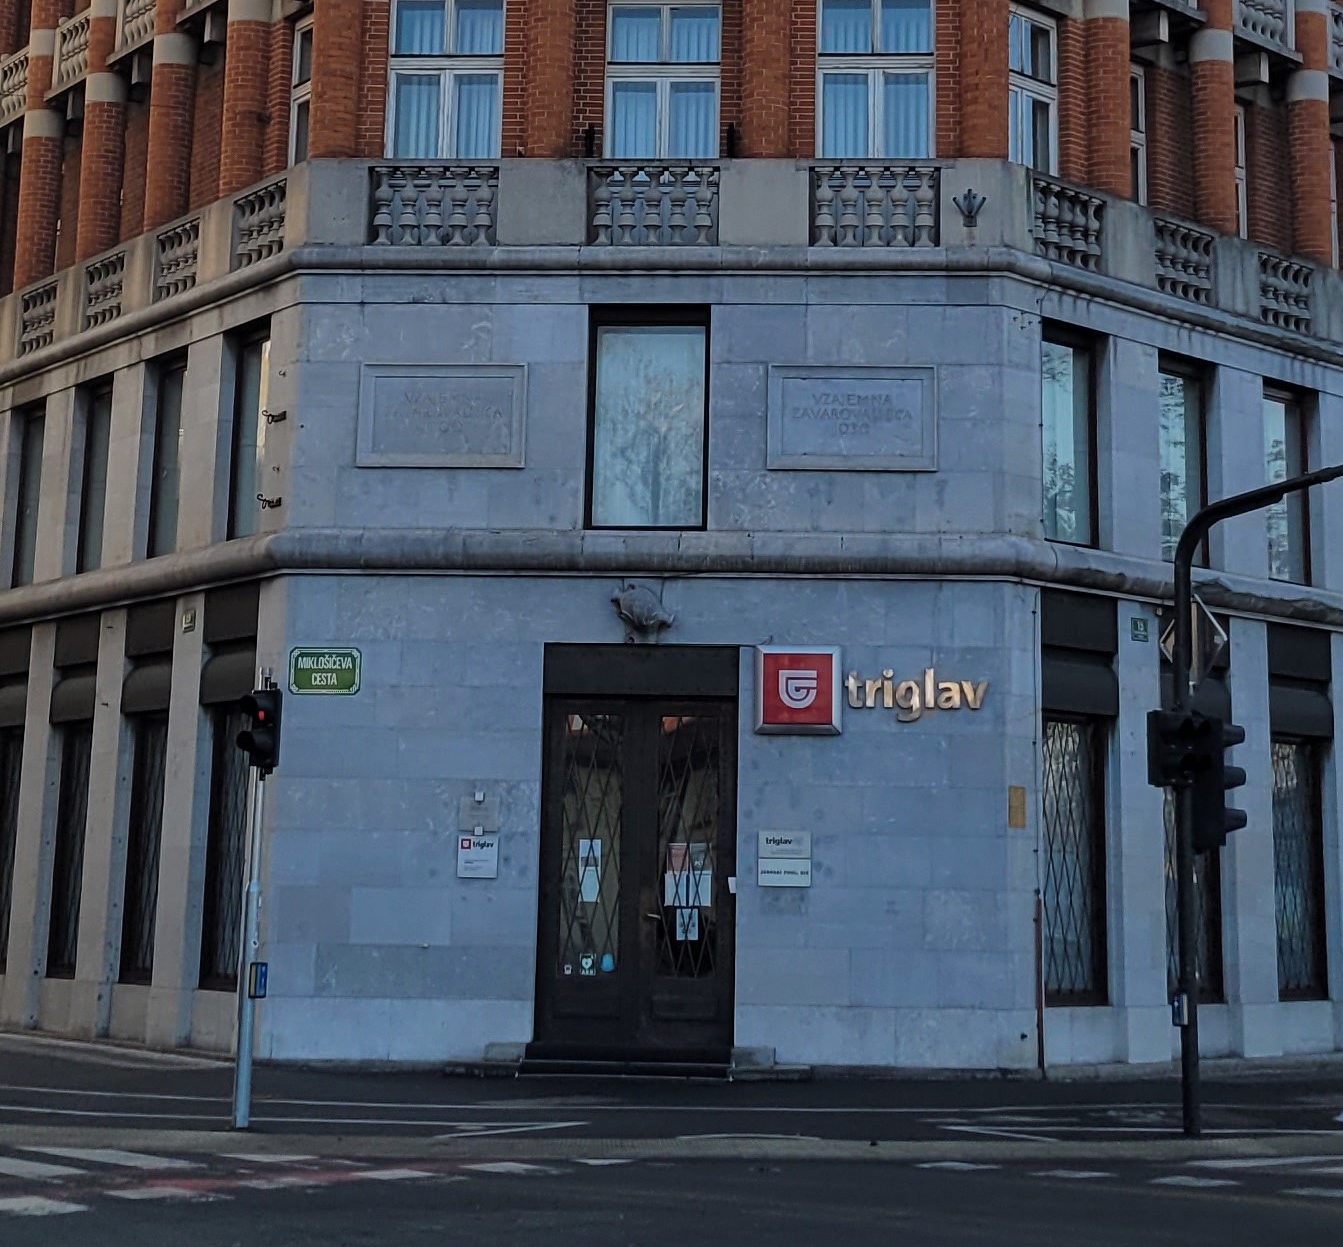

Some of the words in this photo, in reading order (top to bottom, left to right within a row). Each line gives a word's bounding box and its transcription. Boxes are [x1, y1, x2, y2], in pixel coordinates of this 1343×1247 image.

[812, 393, 893, 405] VZAJEMNA
[297, 654, 353, 669] MIKLOŠIČEVA
[311, 672, 338, 686] CESTA
[844, 667, 989, 722] triglav
[472, 840, 494, 850] triglav
[765, 836, 793, 847] triglav
